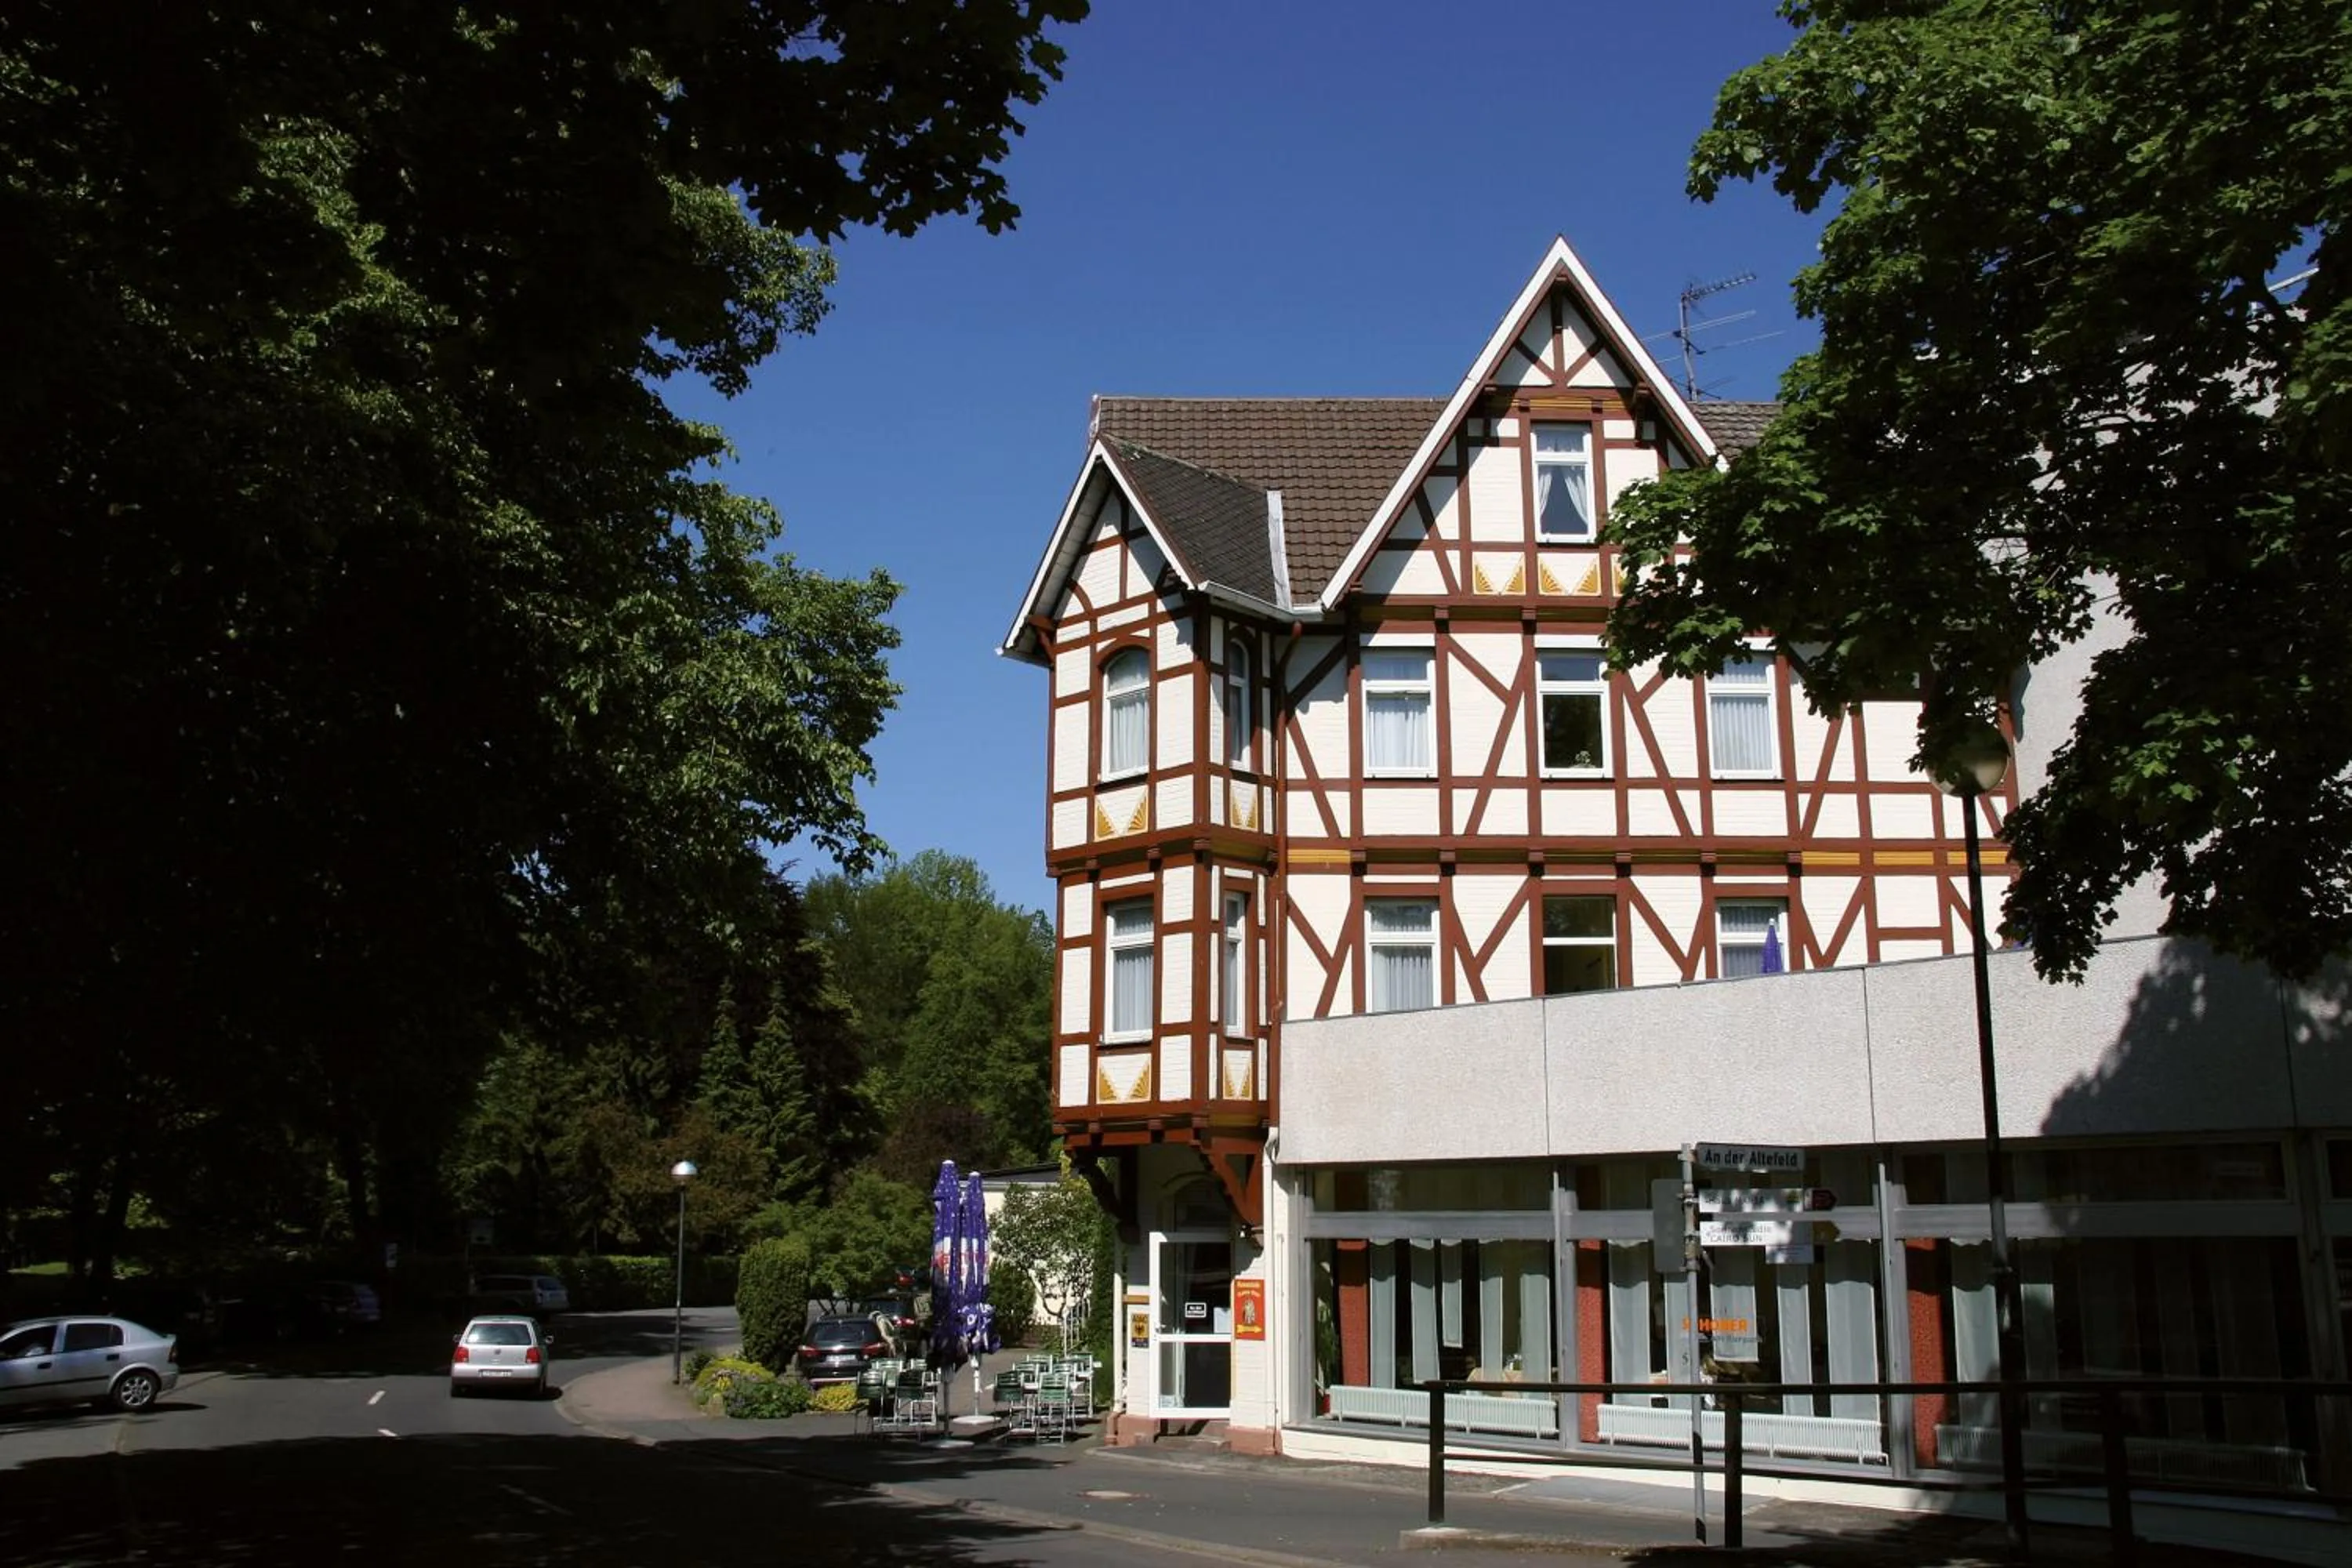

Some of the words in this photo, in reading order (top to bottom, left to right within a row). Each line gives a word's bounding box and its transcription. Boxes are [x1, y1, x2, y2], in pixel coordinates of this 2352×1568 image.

[1704, 1149, 1721, 1164] An
[1724, 1149, 1744, 1165] der
[1749, 1150, 1798, 1167] Altefeld
